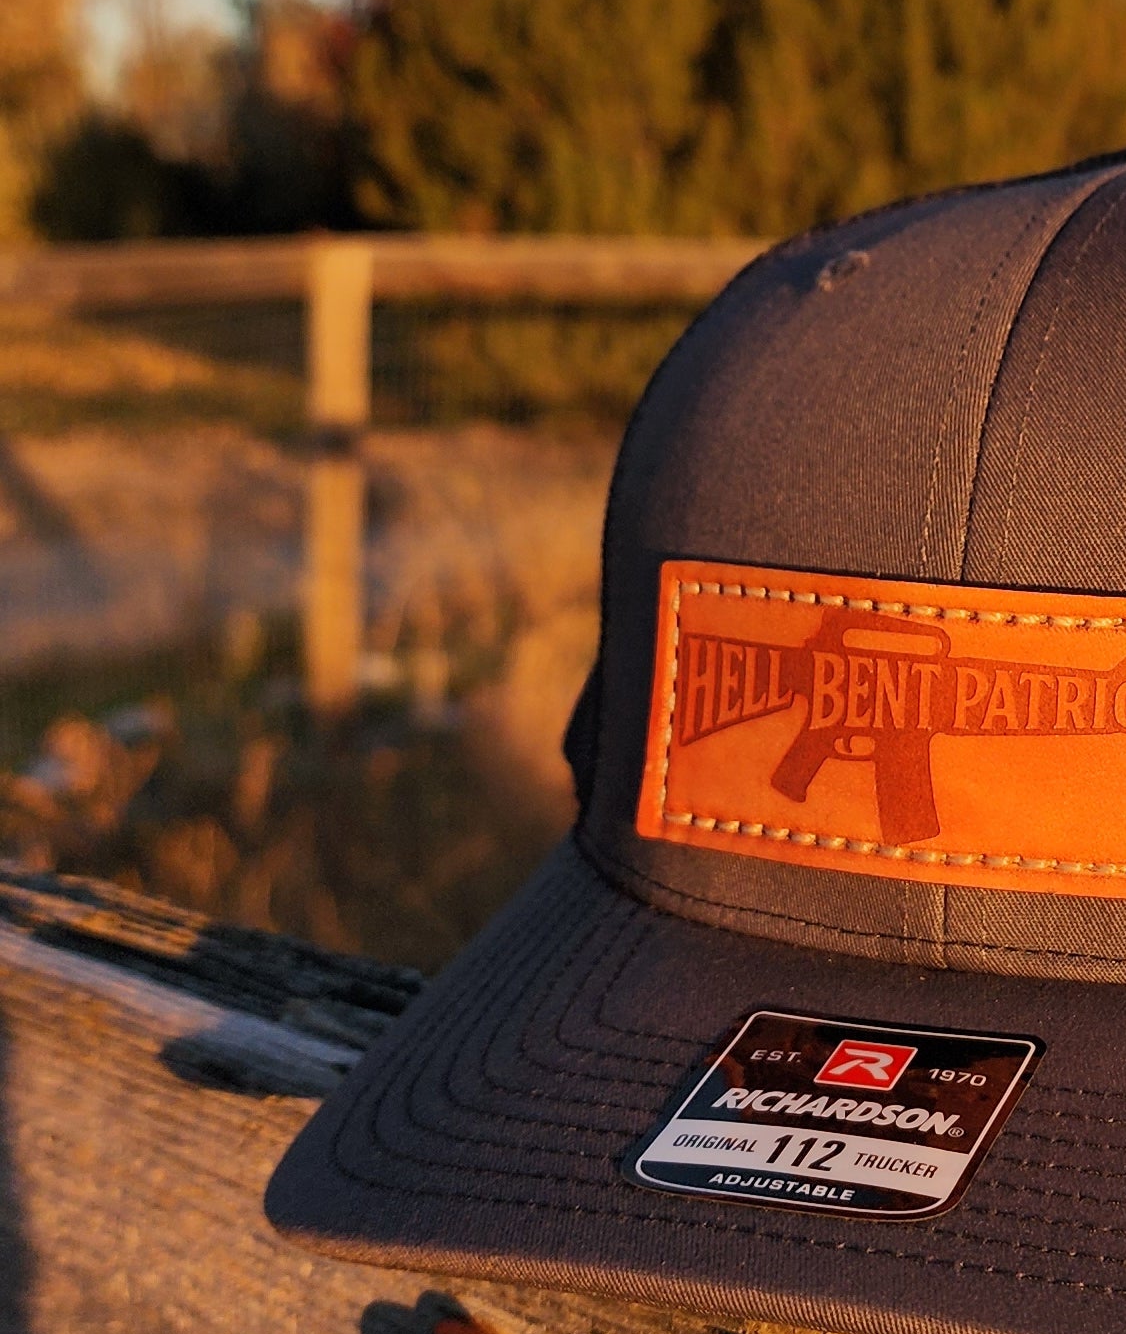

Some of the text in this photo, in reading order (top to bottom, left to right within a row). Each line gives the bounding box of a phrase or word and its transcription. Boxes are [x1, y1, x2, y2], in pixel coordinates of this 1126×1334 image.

[682, 637, 793, 739] HELL
[809, 651, 942, 730] BENT
[750, 1048, 987, 1087] EST. 1970
[673, 1134, 938, 1179] ORIGINAL 112 TRUCKER
[709, 1173, 856, 1201] ADJUSTABLE
